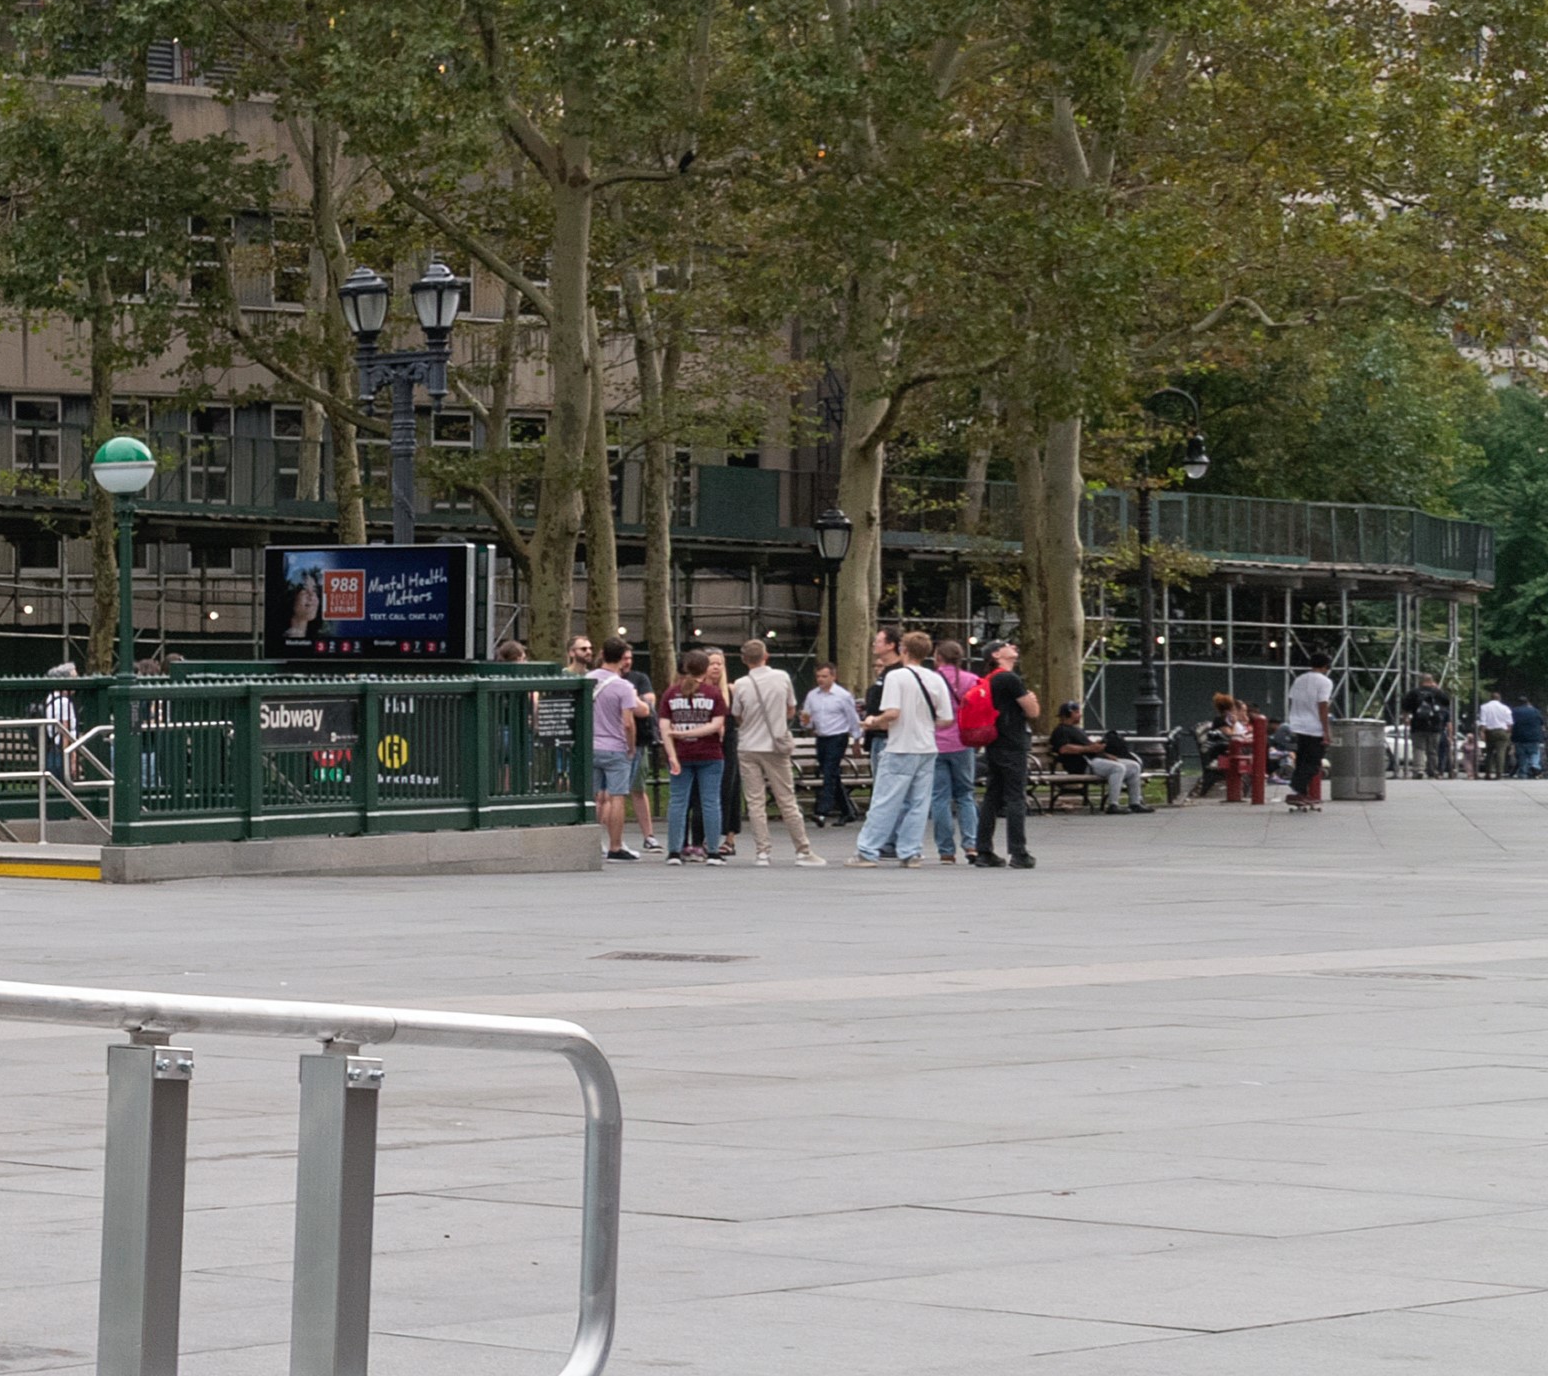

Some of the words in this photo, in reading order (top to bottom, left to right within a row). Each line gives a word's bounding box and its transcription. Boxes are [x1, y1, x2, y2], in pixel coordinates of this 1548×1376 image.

[330, 577, 358, 592] 988
[367, 573, 406, 594] Mental
[408, 568, 448, 587] Health
[385, 591, 434, 608] Matters
[692, 698, 714, 710] YOU
[259, 704, 323, 732] Subway
